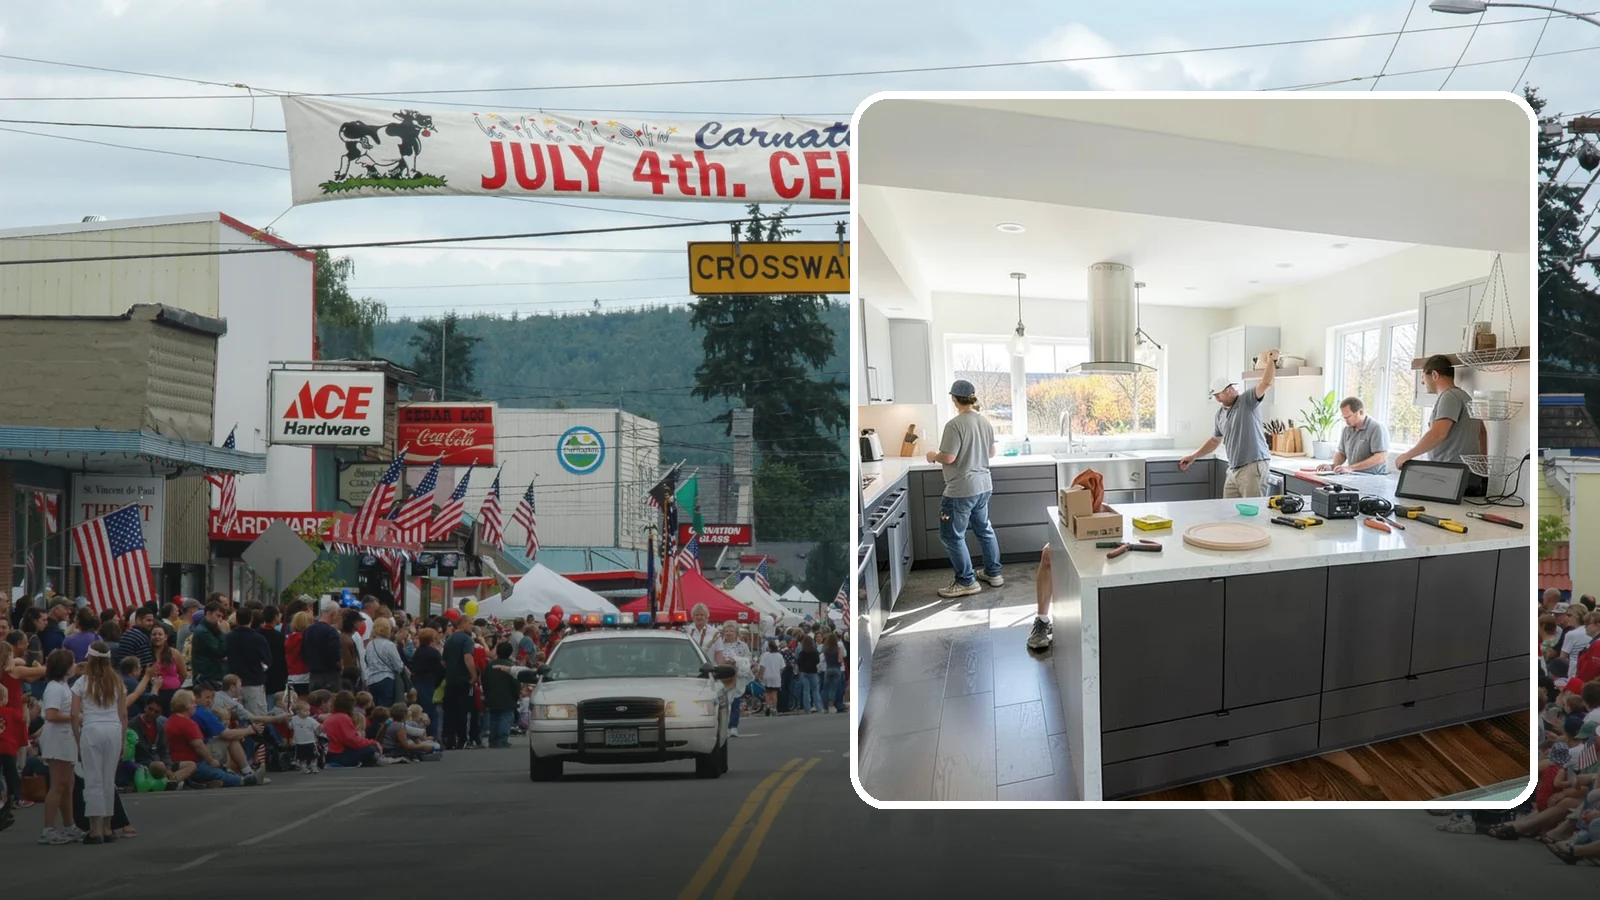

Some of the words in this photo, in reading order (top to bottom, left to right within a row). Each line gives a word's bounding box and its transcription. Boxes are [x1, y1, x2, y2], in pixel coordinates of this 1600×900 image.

[481, 141, 604, 192] JULY
[632, 150, 746, 197] 4th.
[697, 254, 850, 280] CROSSWA
[283, 380, 373, 420] ACE
[405, 409, 452, 422] CEDAR
[284, 421, 370, 436] Hardware
[416, 428, 476, 447] Coca-Cola
[83, 485, 93, 494] St.
[95, 485, 124, 495] Vincent
[126, 485, 135, 495] de
[137, 485, 155, 496] Paul
[688, 526, 742, 535] CRNATION
[699, 535, 730, 543] GLASS
